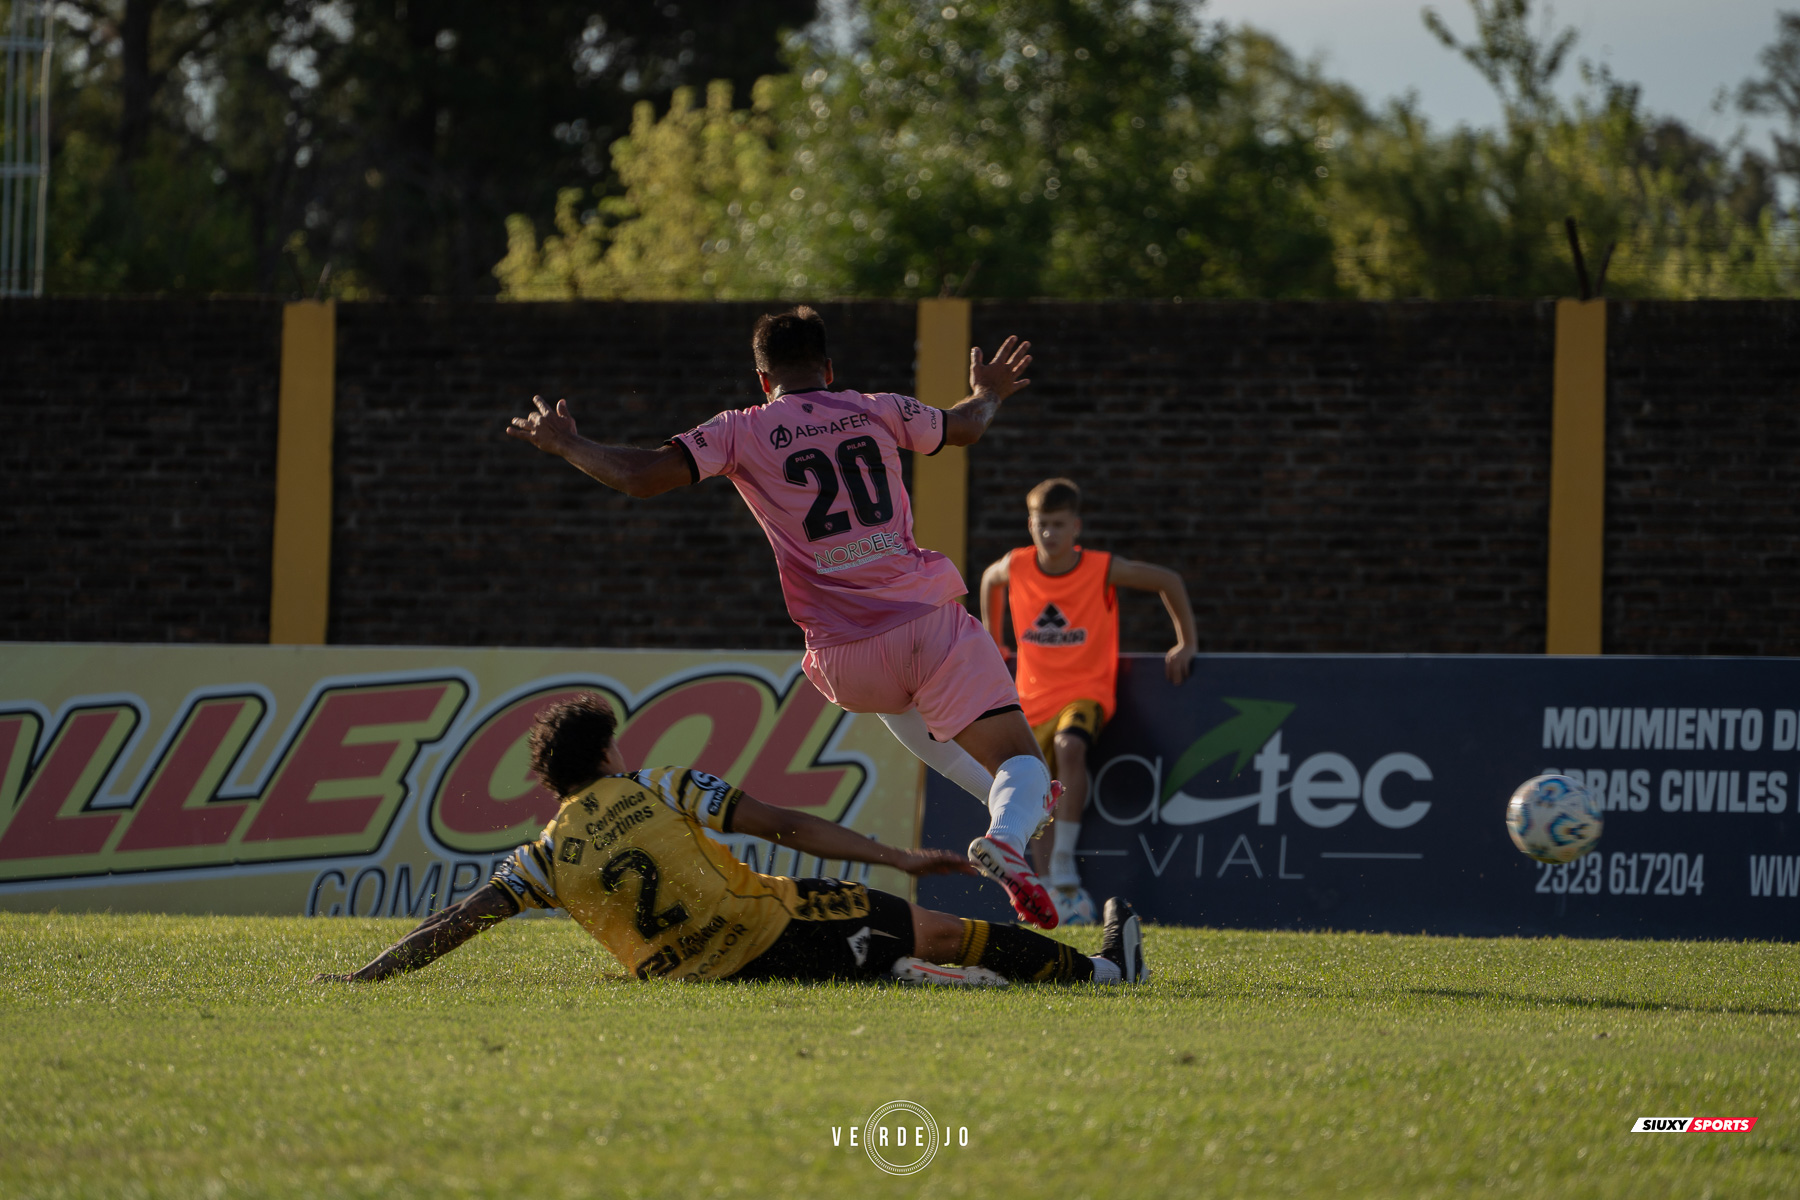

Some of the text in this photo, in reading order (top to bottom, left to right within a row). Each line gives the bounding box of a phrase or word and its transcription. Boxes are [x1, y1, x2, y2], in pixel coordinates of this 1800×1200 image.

[796, 413, 871, 439] ABRAFER
[846, 441, 867, 451] PILAR
[795, 453, 815, 463] PILAR
[783, 435, 893, 542] 20
[1542, 706, 1800, 751] MOVIMIENTO D
[585, 790, 647, 836] Cerámica
[1541, 768, 1650, 812] RAS
[1660, 769, 1788, 813] CIVILES
[593, 804, 654, 852] Cortines
[1138, 833, 1304, 879] VIAL
[1535, 852, 1602, 894] 2323
[1609, 852, 1704, 896] 617204
[601, 848, 690, 942] 2
